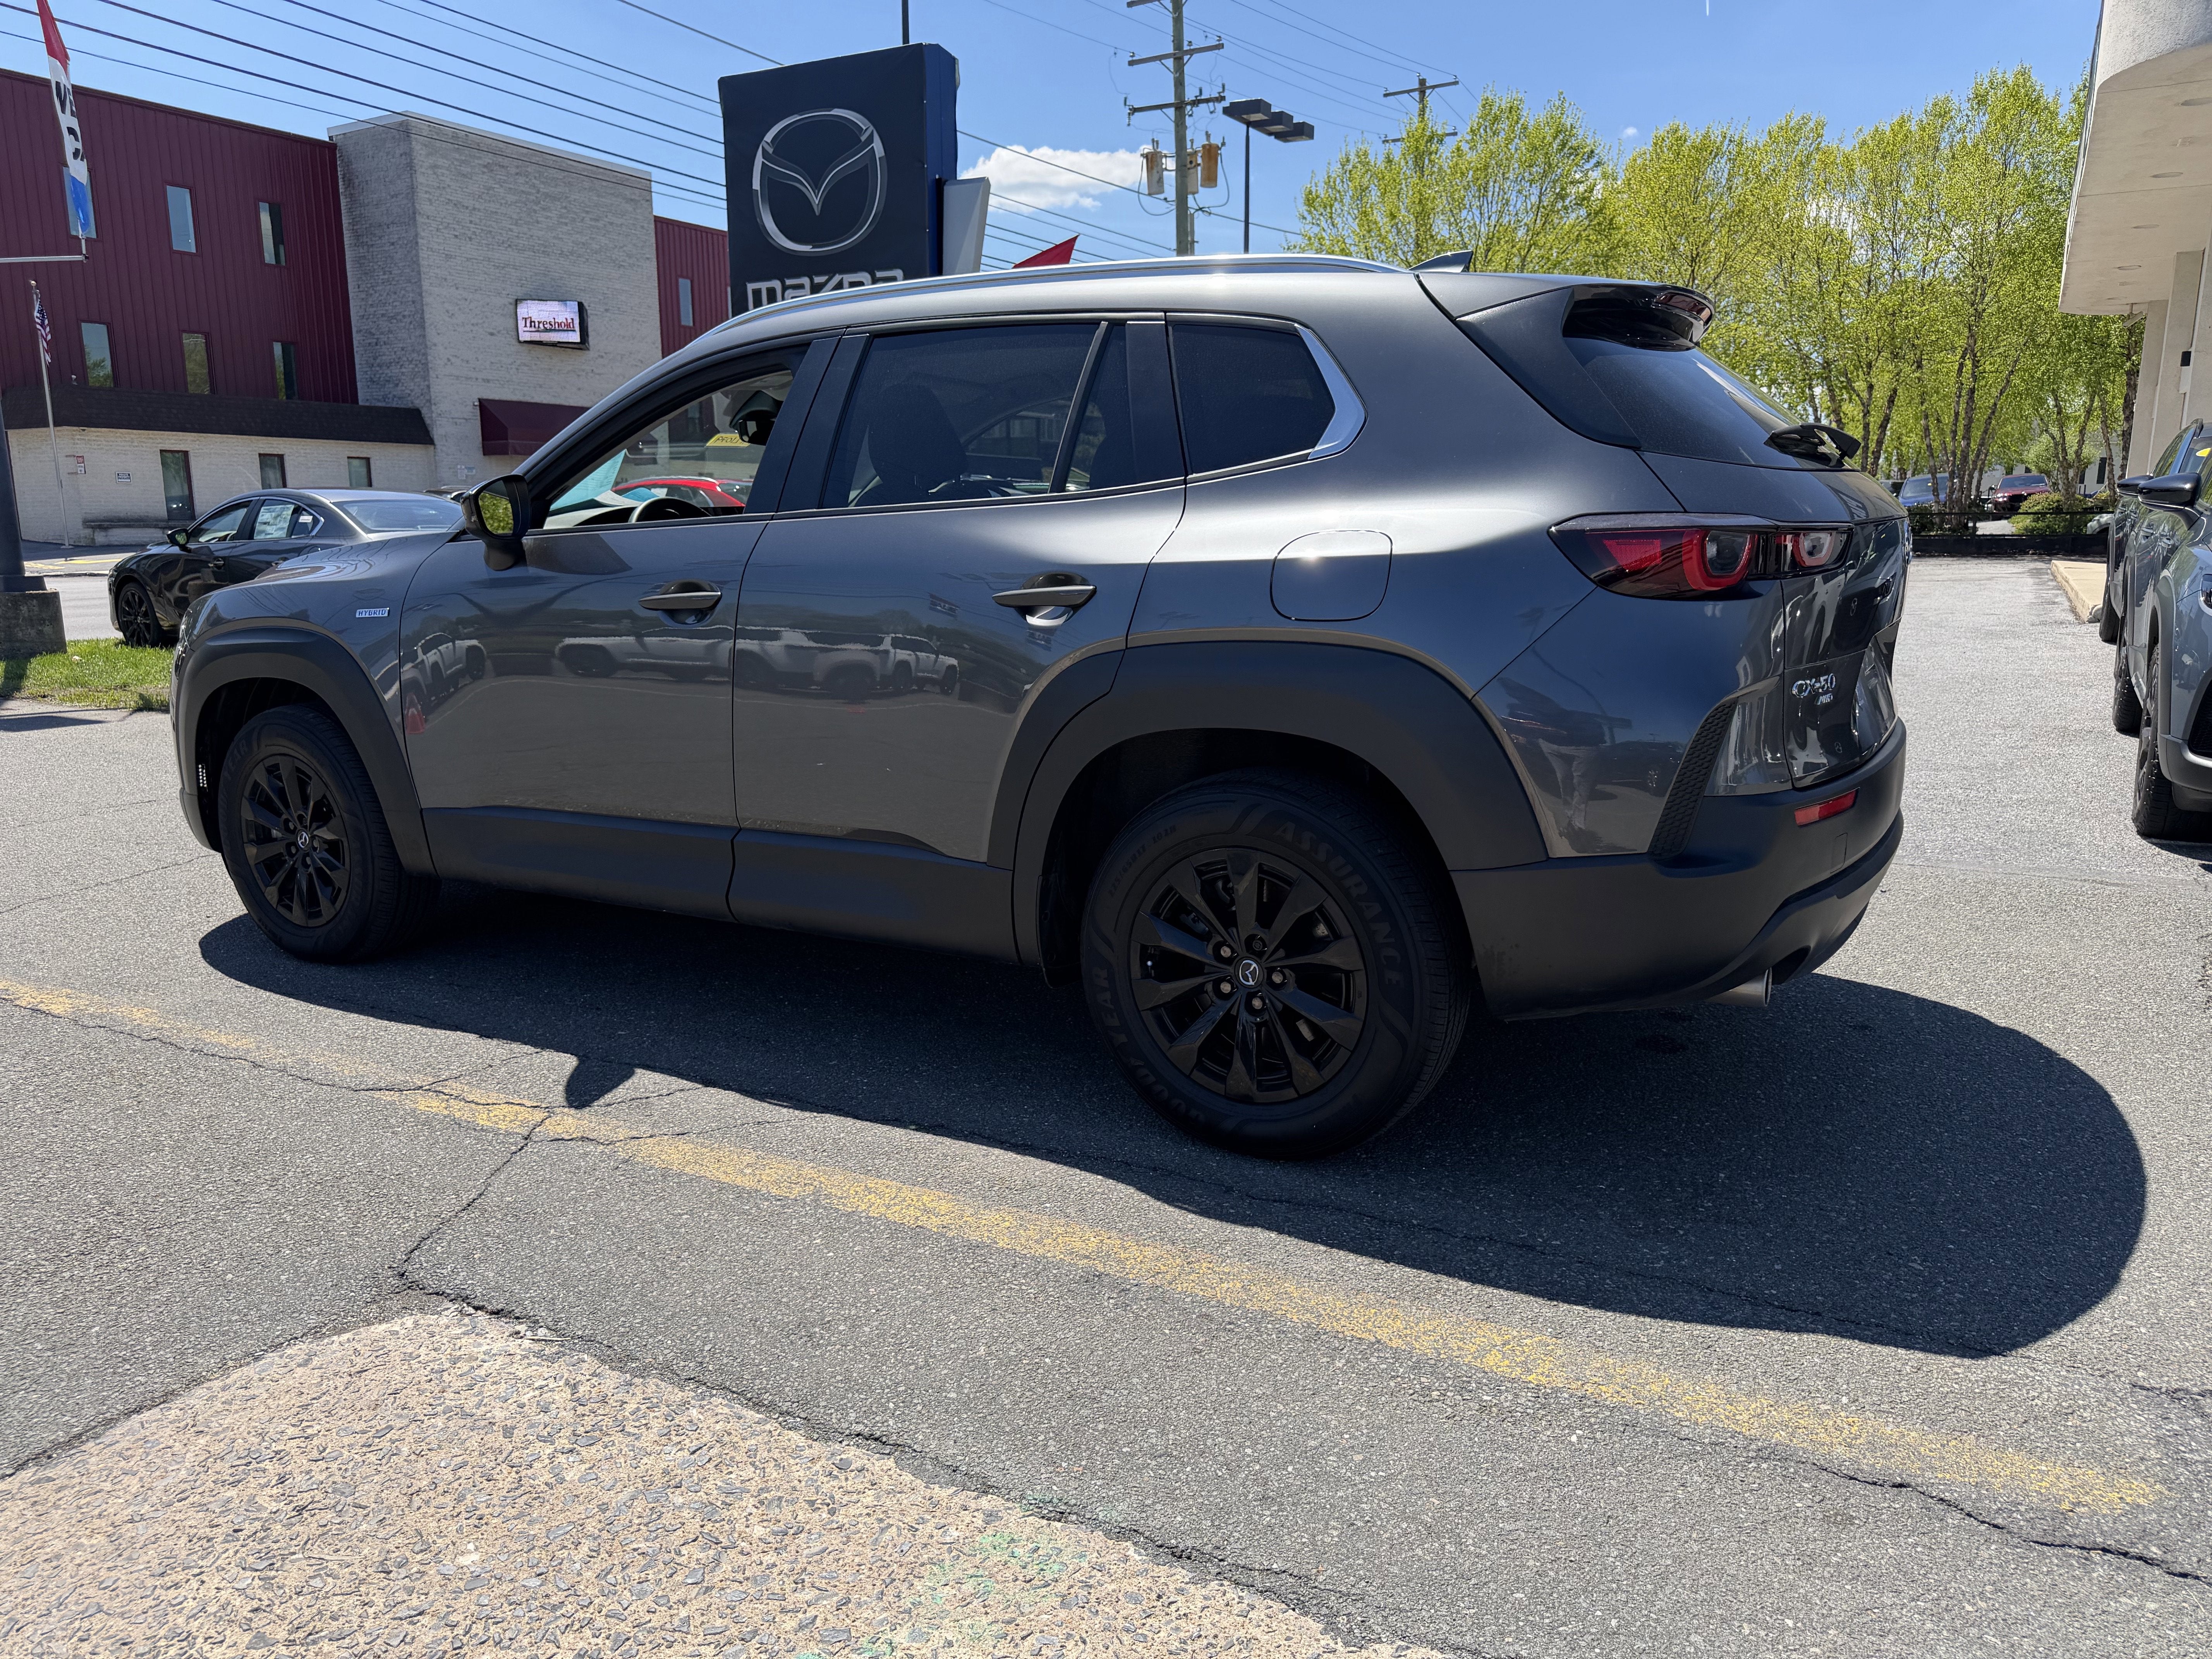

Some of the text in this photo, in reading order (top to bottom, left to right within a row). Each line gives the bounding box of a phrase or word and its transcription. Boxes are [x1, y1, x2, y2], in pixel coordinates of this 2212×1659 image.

[522, 316, 575, 329] Threshold
[1791, 673, 1836, 698] CX-50
[1274, 821, 1406, 988] ASSURANCE
